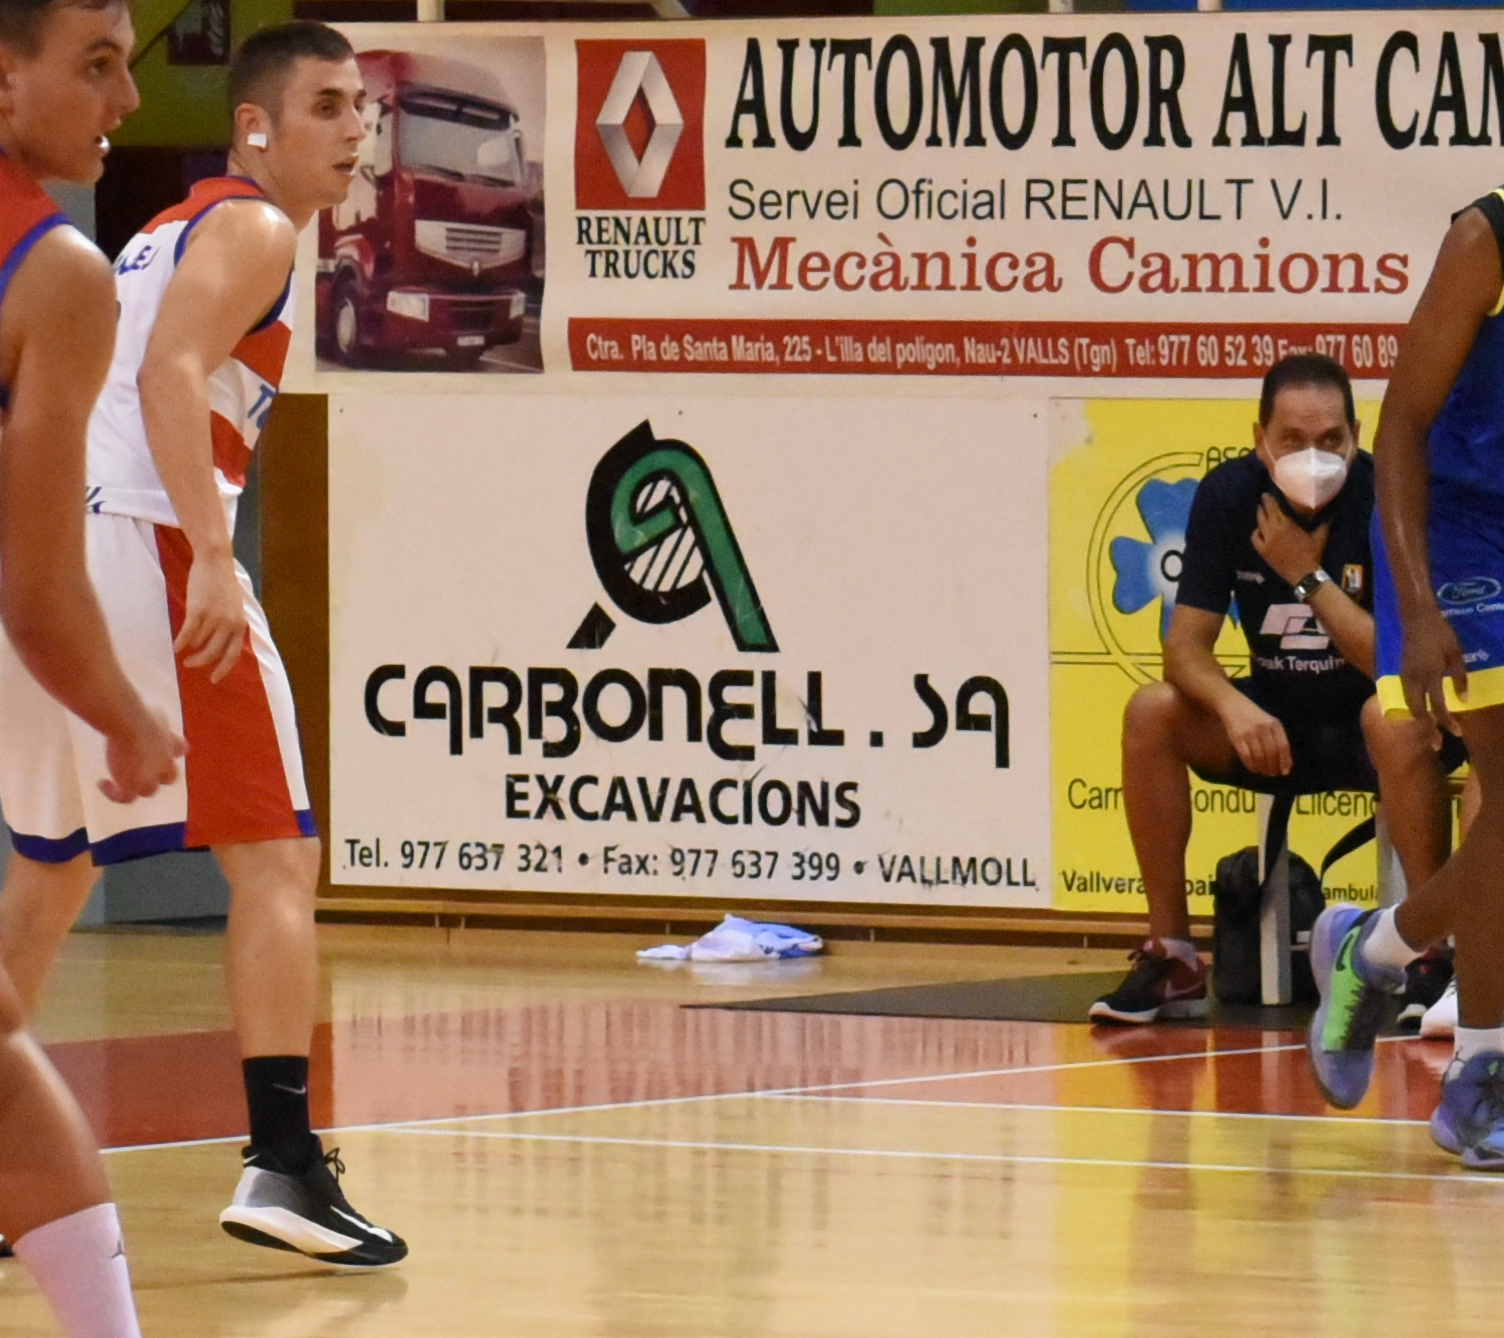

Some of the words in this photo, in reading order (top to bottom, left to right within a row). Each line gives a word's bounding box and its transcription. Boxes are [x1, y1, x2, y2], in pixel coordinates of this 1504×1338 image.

[726, 32, 1192, 151] AUTOMOTOR
[1213, 32, 1354, 149] ALT
[728, 178, 861, 222] Servei
[875, 177, 1008, 222] Oficial
[1024, 177, 1256, 222] RENAULT
[1270, 177, 1343, 222] V.I.
[576, 215, 706, 248] RENAULT
[585, 248, 697, 280] TRUCKS
[728, 231, 1063, 293] Mecànica
[1089, 234, 1410, 295] Camions
[586, 334, 624, 362] Ctra.
[631, 334, 656, 362] Pla
[660, 334, 680, 362] de
[683, 334, 727, 363] Santa
[783, 335, 812, 363] 225
[825, 335, 865, 363] L'illa
[867, 335, 893, 364] del
[963, 337, 1012, 365] Nau-2
[1012, 338, 1070, 365] VALLS
[1073, 338, 1117, 373] (Tgn)
[1157, 334, 1192, 366] 977
[1197, 334, 1220, 367] 60
[1223, 335, 1247, 367] 52
[1251, 335, 1275, 367] 39
[1351, 334, 1375, 368] 60
[364, 663, 845, 764] CARBONELL
[505, 773, 861, 830] EXCAVACIONS
[345, 838, 390, 872] Tel.
[400, 839, 448, 873] 977
[457, 840, 506, 874] 637
[516, 843, 564, 875] 321
[601, 845, 659, 878] Fax:
[670, 848, 719, 880] 977
[729, 850, 779, 882] 637
[790, 851, 841, 884] 399
[877, 852, 1039, 892] VALLMOLL
